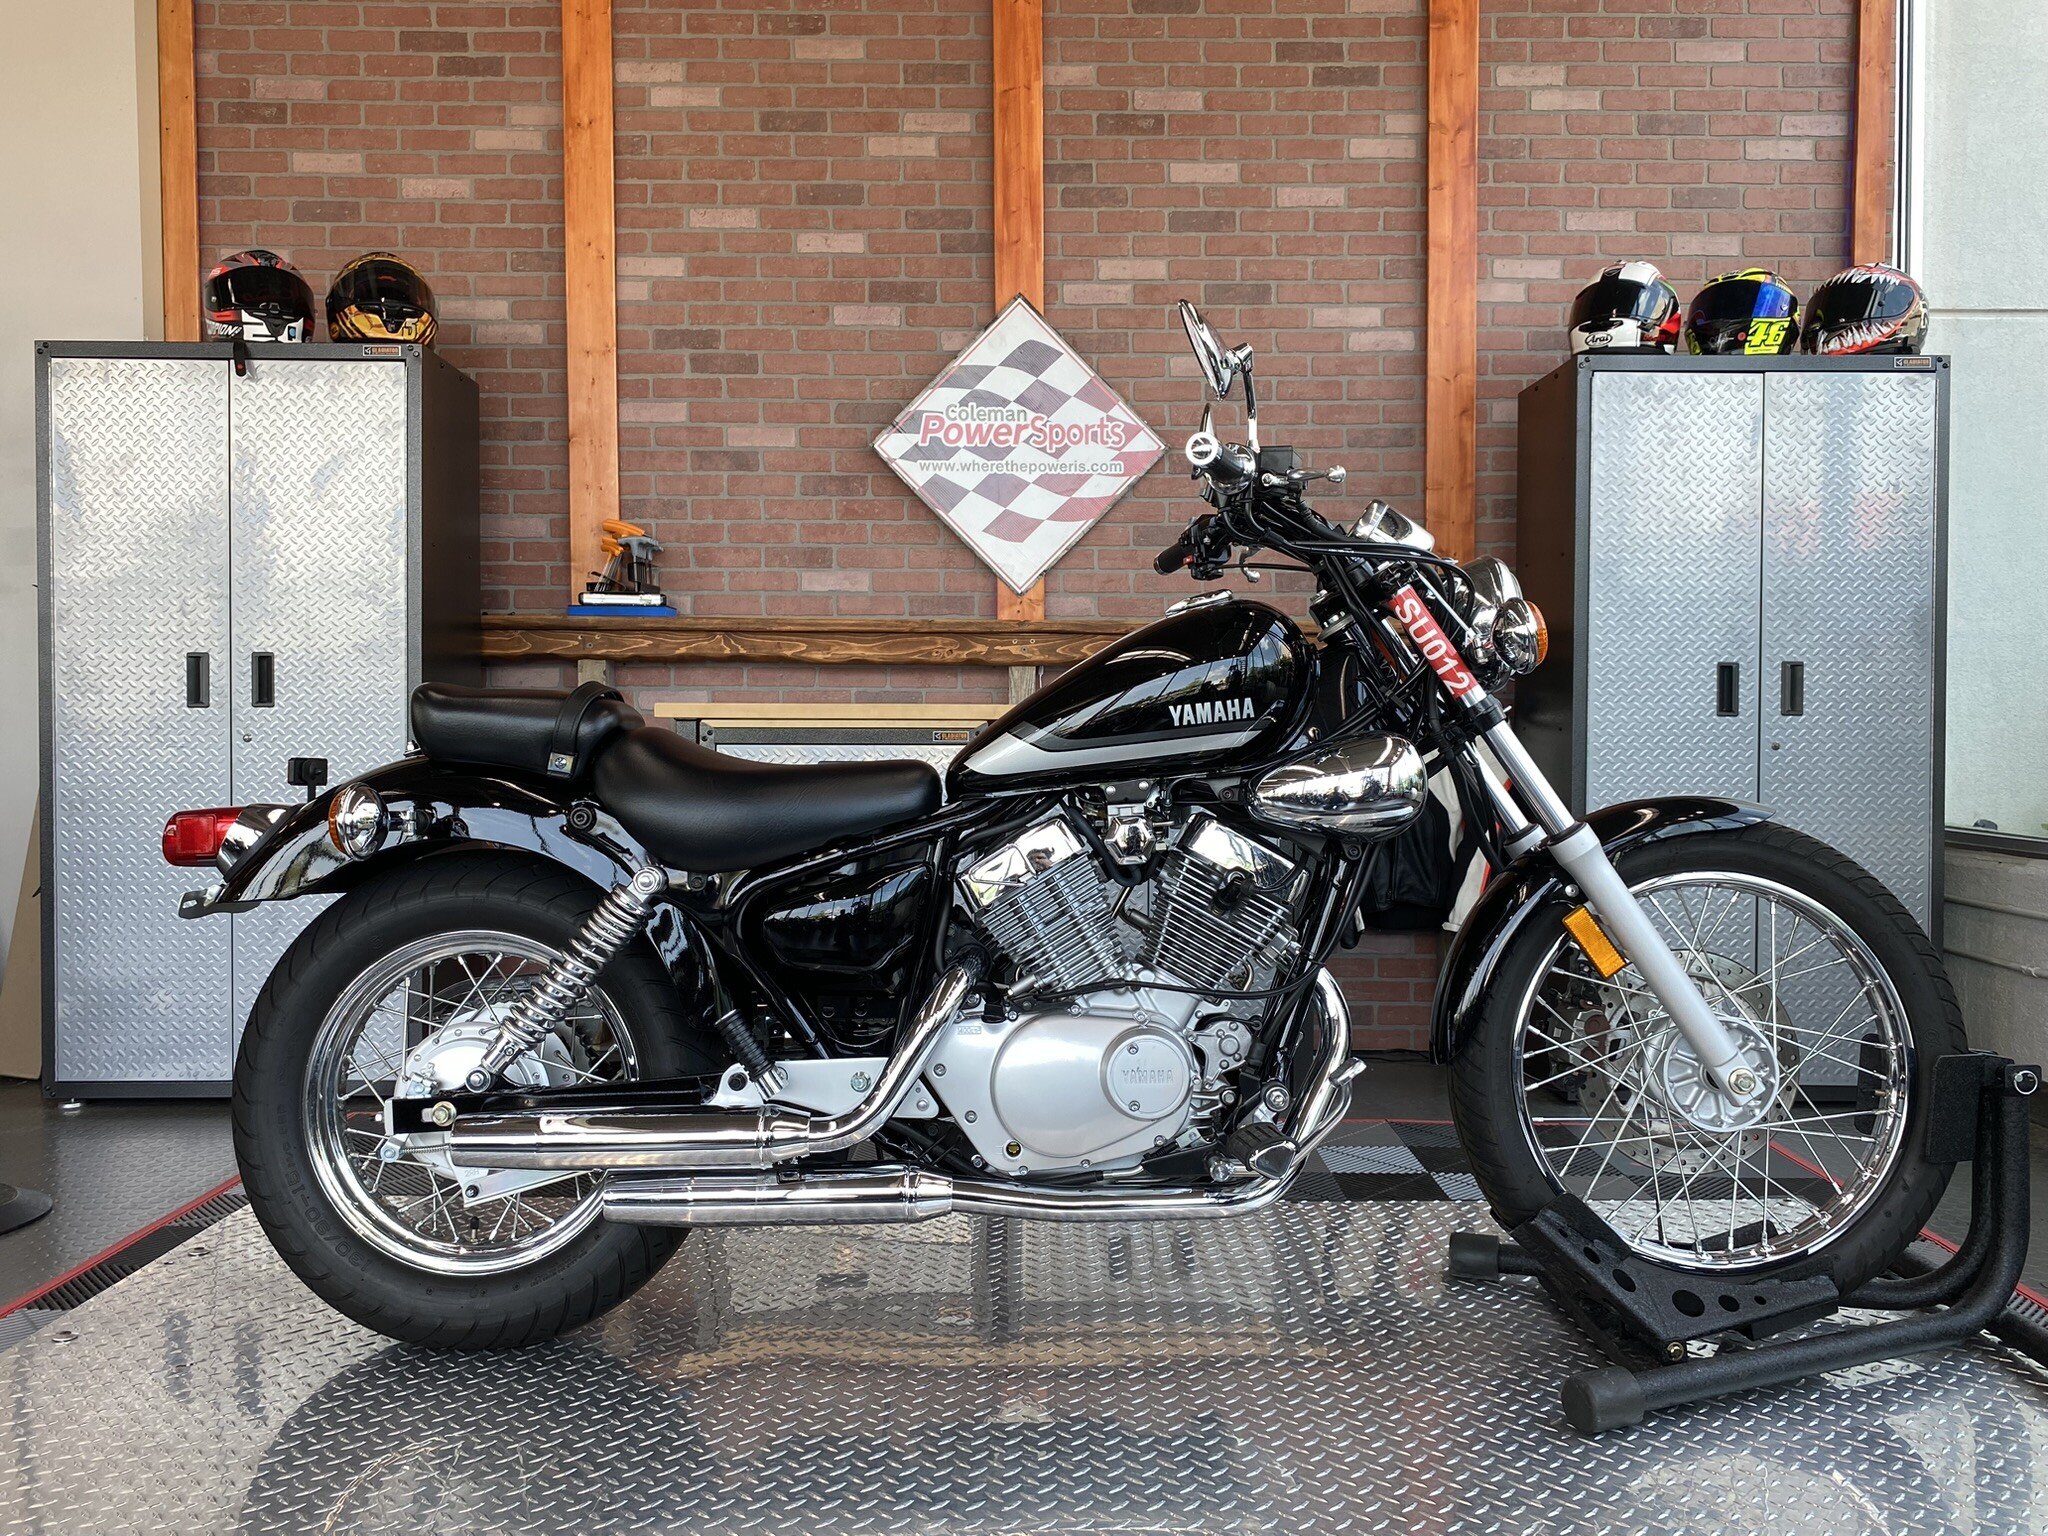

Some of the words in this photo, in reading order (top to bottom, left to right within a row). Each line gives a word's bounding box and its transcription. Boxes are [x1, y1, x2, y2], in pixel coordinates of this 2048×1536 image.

[1586, 334, 1609, 344] Arai
[1746, 321, 1789, 347] 46
[945, 403, 1028, 422] Coleman
[919, 414, 1125, 451] PowerSports
[919, 459, 1123, 475] www.wherethepoweris.com
[1394, 598, 1471, 695] SU012
[1168, 697, 1255, 727] YAMAHA
[1121, 1067, 1175, 1084] YAMAHA
